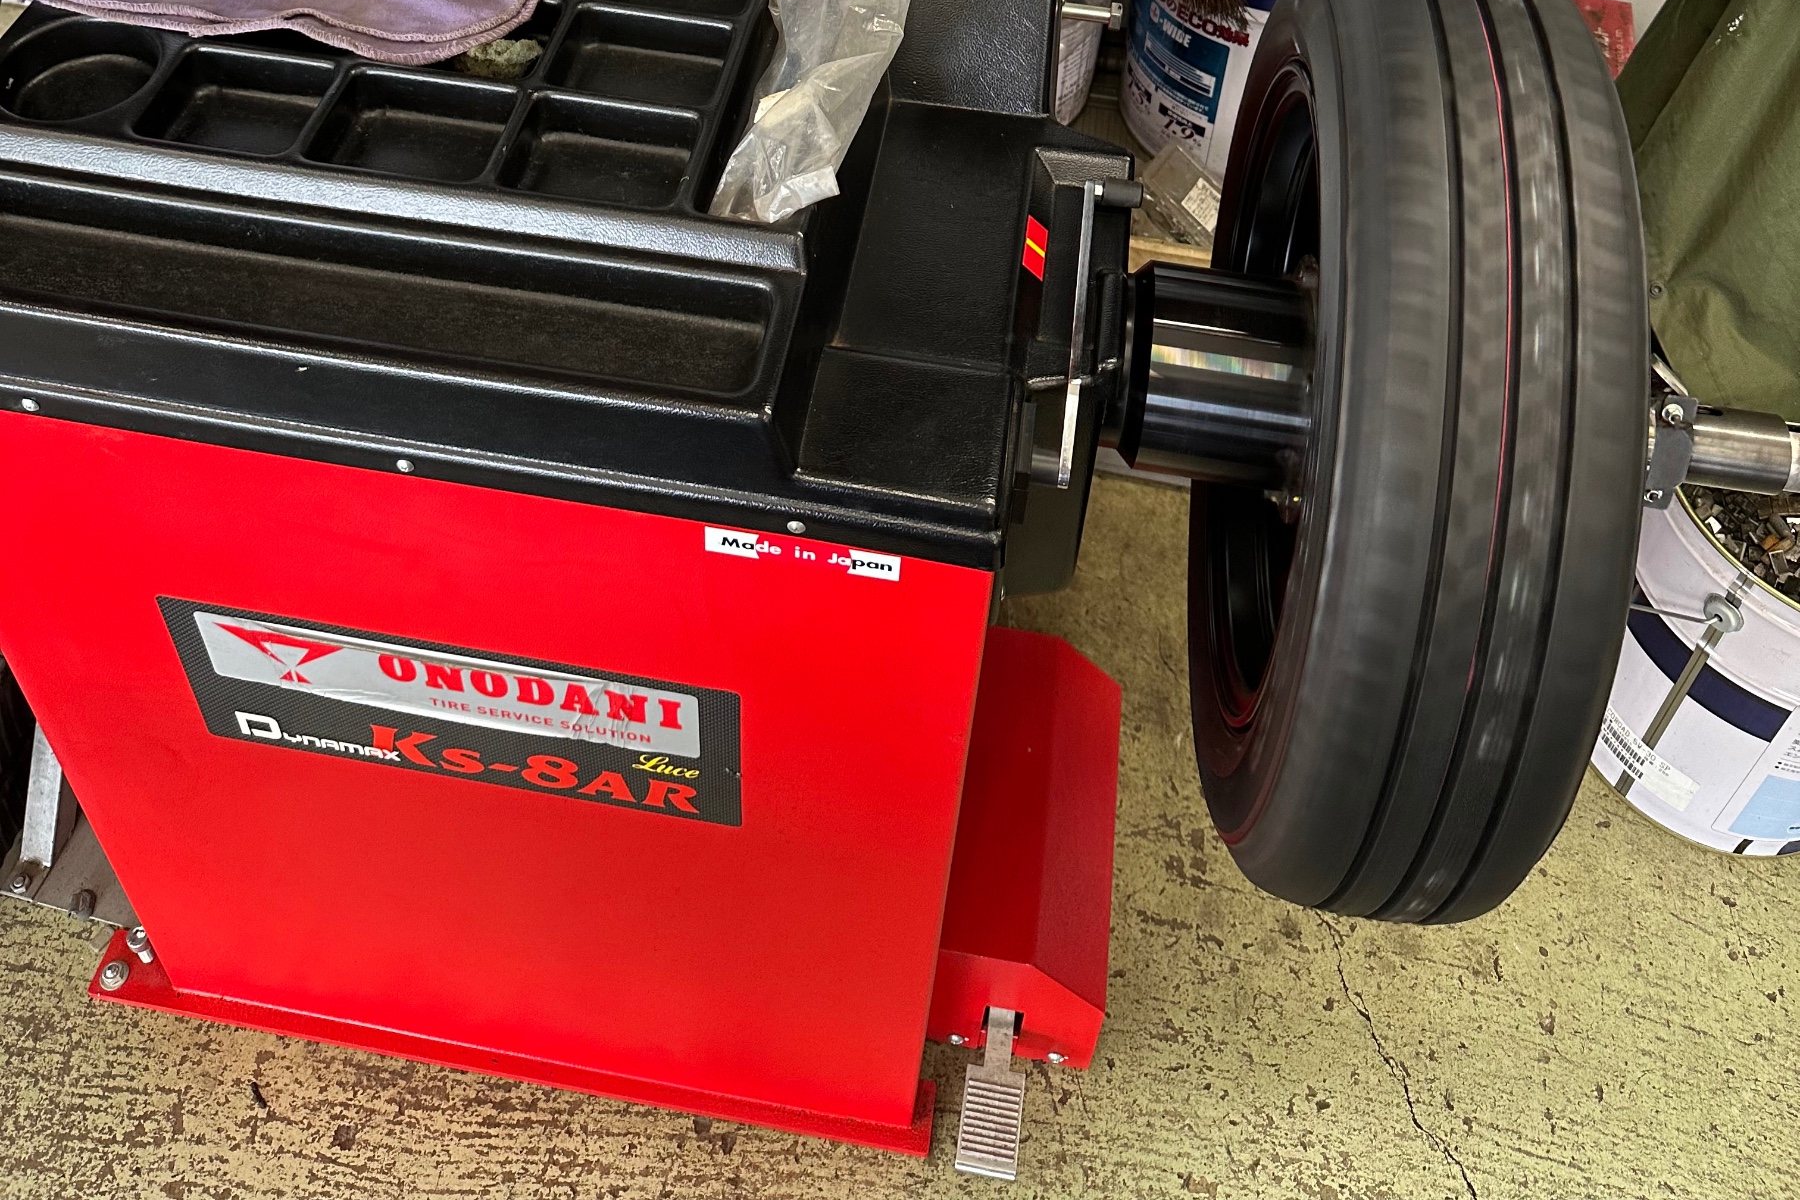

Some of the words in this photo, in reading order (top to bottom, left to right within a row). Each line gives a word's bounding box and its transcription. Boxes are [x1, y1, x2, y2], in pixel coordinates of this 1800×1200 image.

[721, 536, 782, 555] Made
[794, 546, 816, 561] in
[827, 553, 893, 572] Japan
[377, 653, 683, 730] ONODANI
[429, 697, 472, 713] TIRE
[477, 706, 554, 727] SERVICE
[560, 720, 652, 744] SOLUTION
[632, 754, 700, 779] Luce
